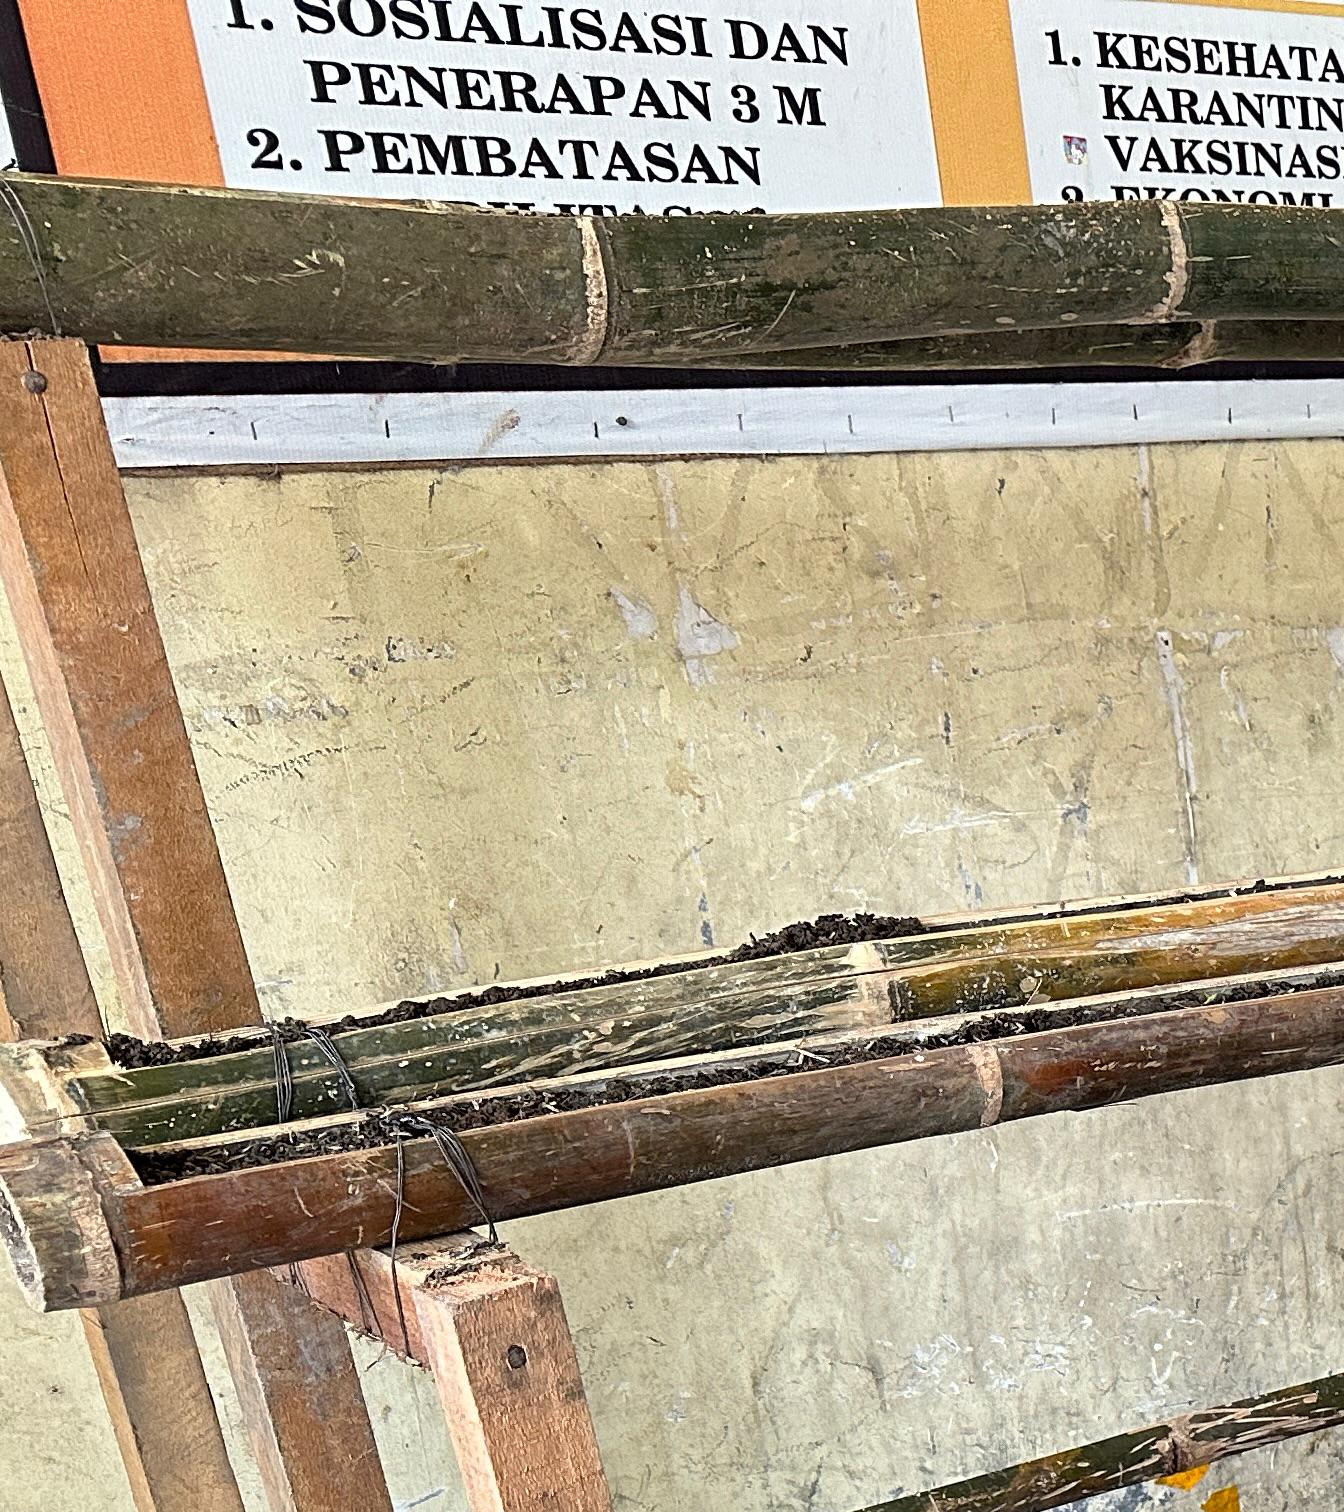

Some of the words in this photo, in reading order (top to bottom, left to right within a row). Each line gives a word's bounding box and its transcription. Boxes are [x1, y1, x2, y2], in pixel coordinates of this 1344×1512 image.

[227, 0, 274, 31] 1.
[294, 0, 712, 57] SOSIALISASI
[724, 19, 849, 66] DAN
[1045, 29, 1082, 67] 1.
[303, 59, 712, 122] PENERAPAN
[731, 84, 760, 123] 3
[773, 85, 827, 126] M
[247, 128, 303, 171] 2.
[317, 129, 761, 186] PEMBATASAN
